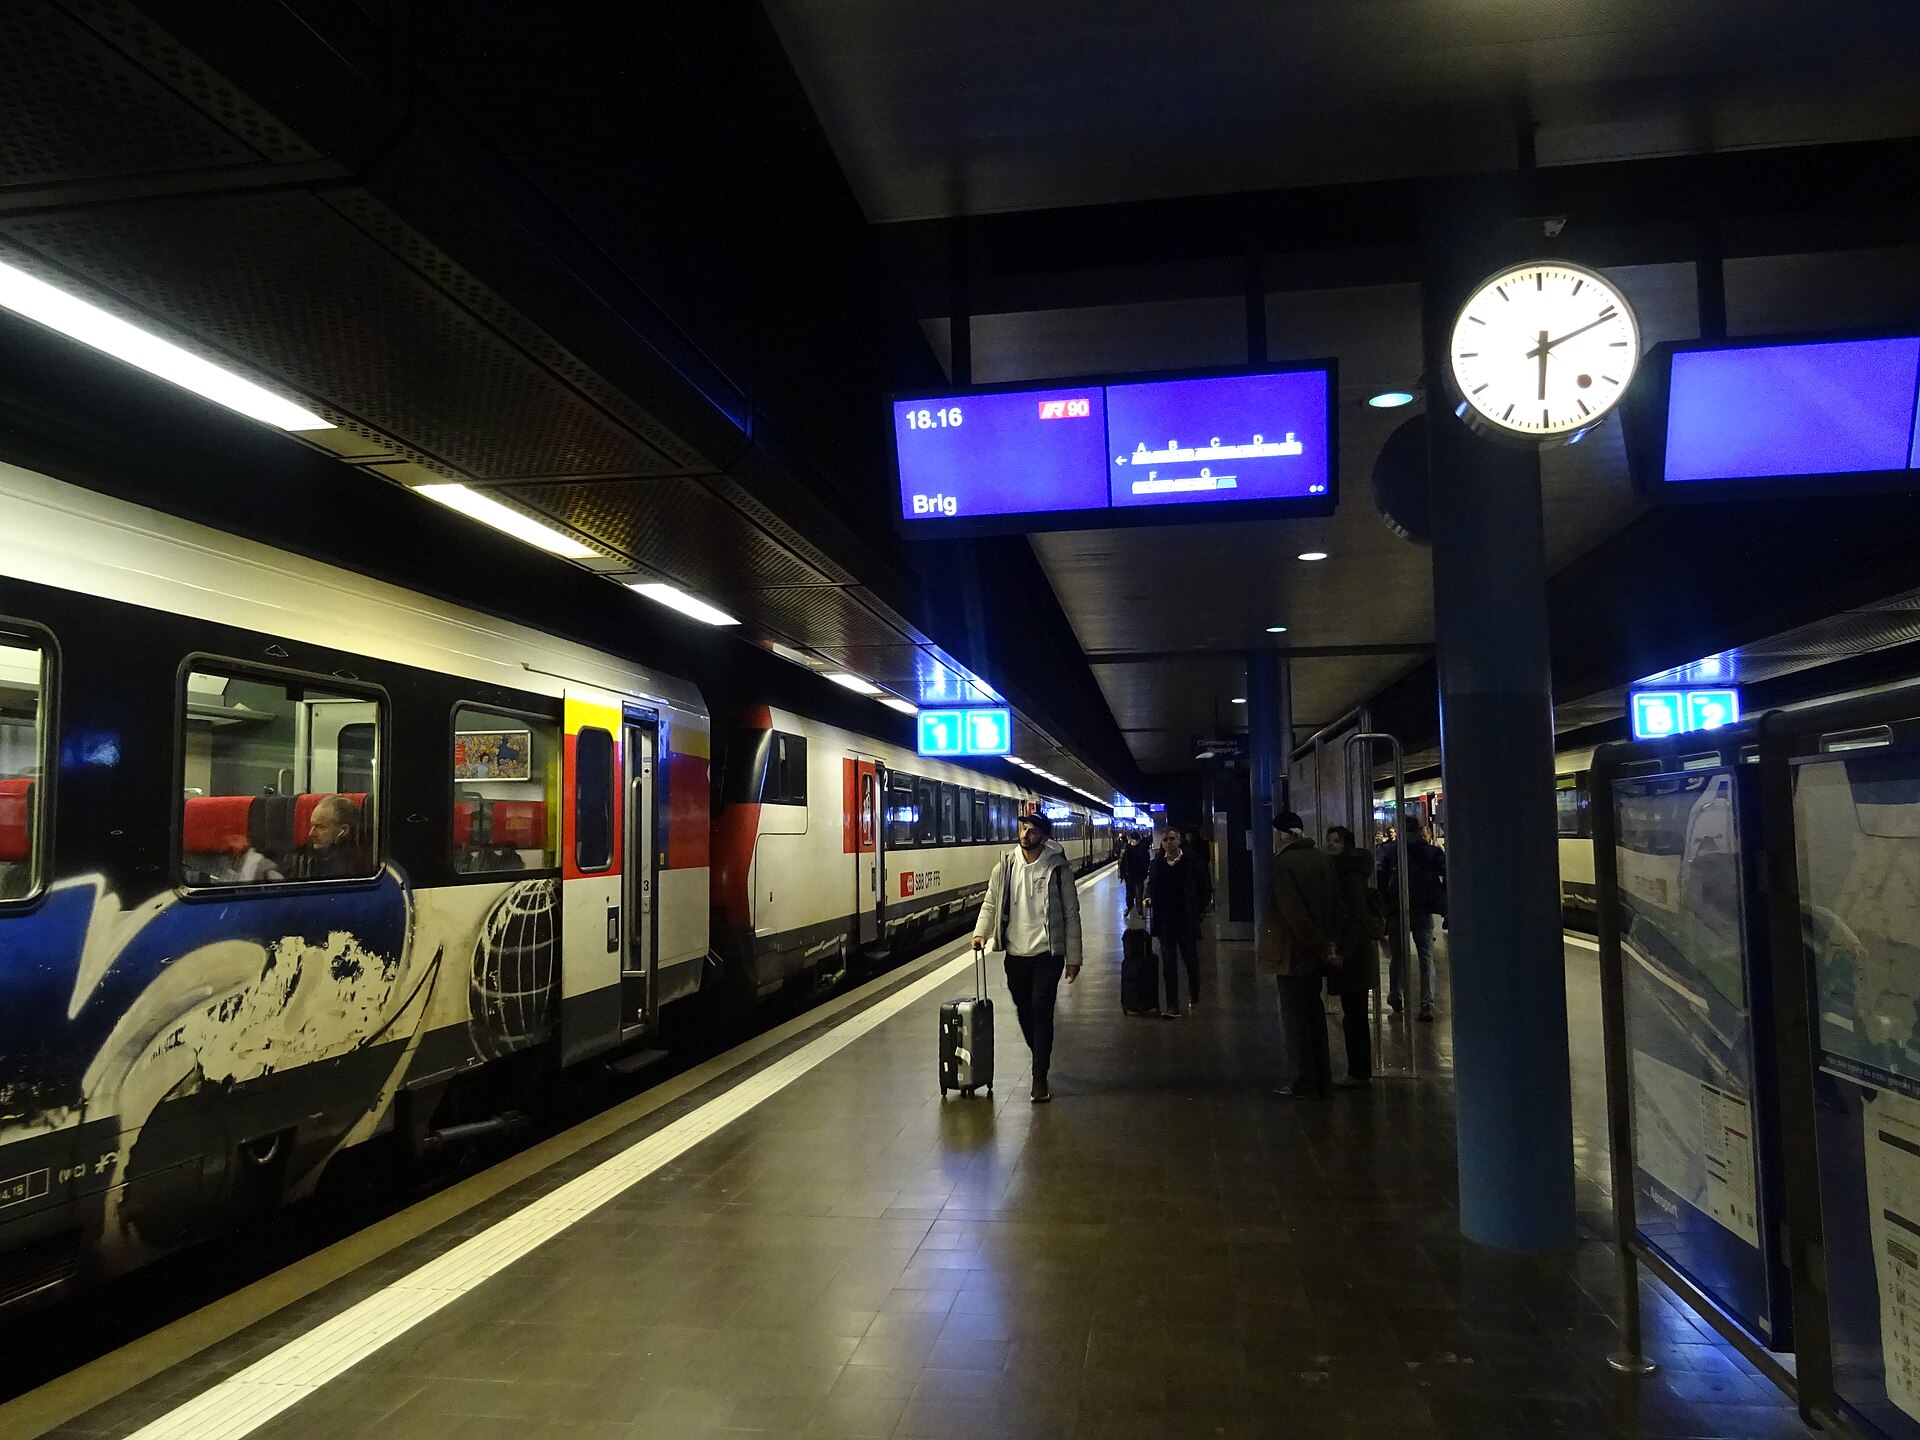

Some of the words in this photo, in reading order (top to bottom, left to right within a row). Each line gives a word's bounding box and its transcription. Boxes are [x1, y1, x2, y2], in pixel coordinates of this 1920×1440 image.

[906, 408, 963, 429] 18.16
[1067, 400, 1089, 416] 90
[1137, 442, 1146, 452] A
[1168, 440, 1178, 450] B
[1210, 437, 1221, 448] C
[1253, 434, 1263, 445] D
[1285, 432, 1295, 443] E
[1149, 471, 1157, 481] F
[1200, 468, 1211, 478] G
[912, 494, 957, 516] Brig
[1702, 704, 1724, 730] 2
[933, 724, 946, 748] 1
[883, 770, 889, 791] 2
[643, 880, 650, 891] 3
[915, 873, 924, 891] SBB
[925, 871, 933, 889] CFF
[933, 870, 941, 886] FFS
